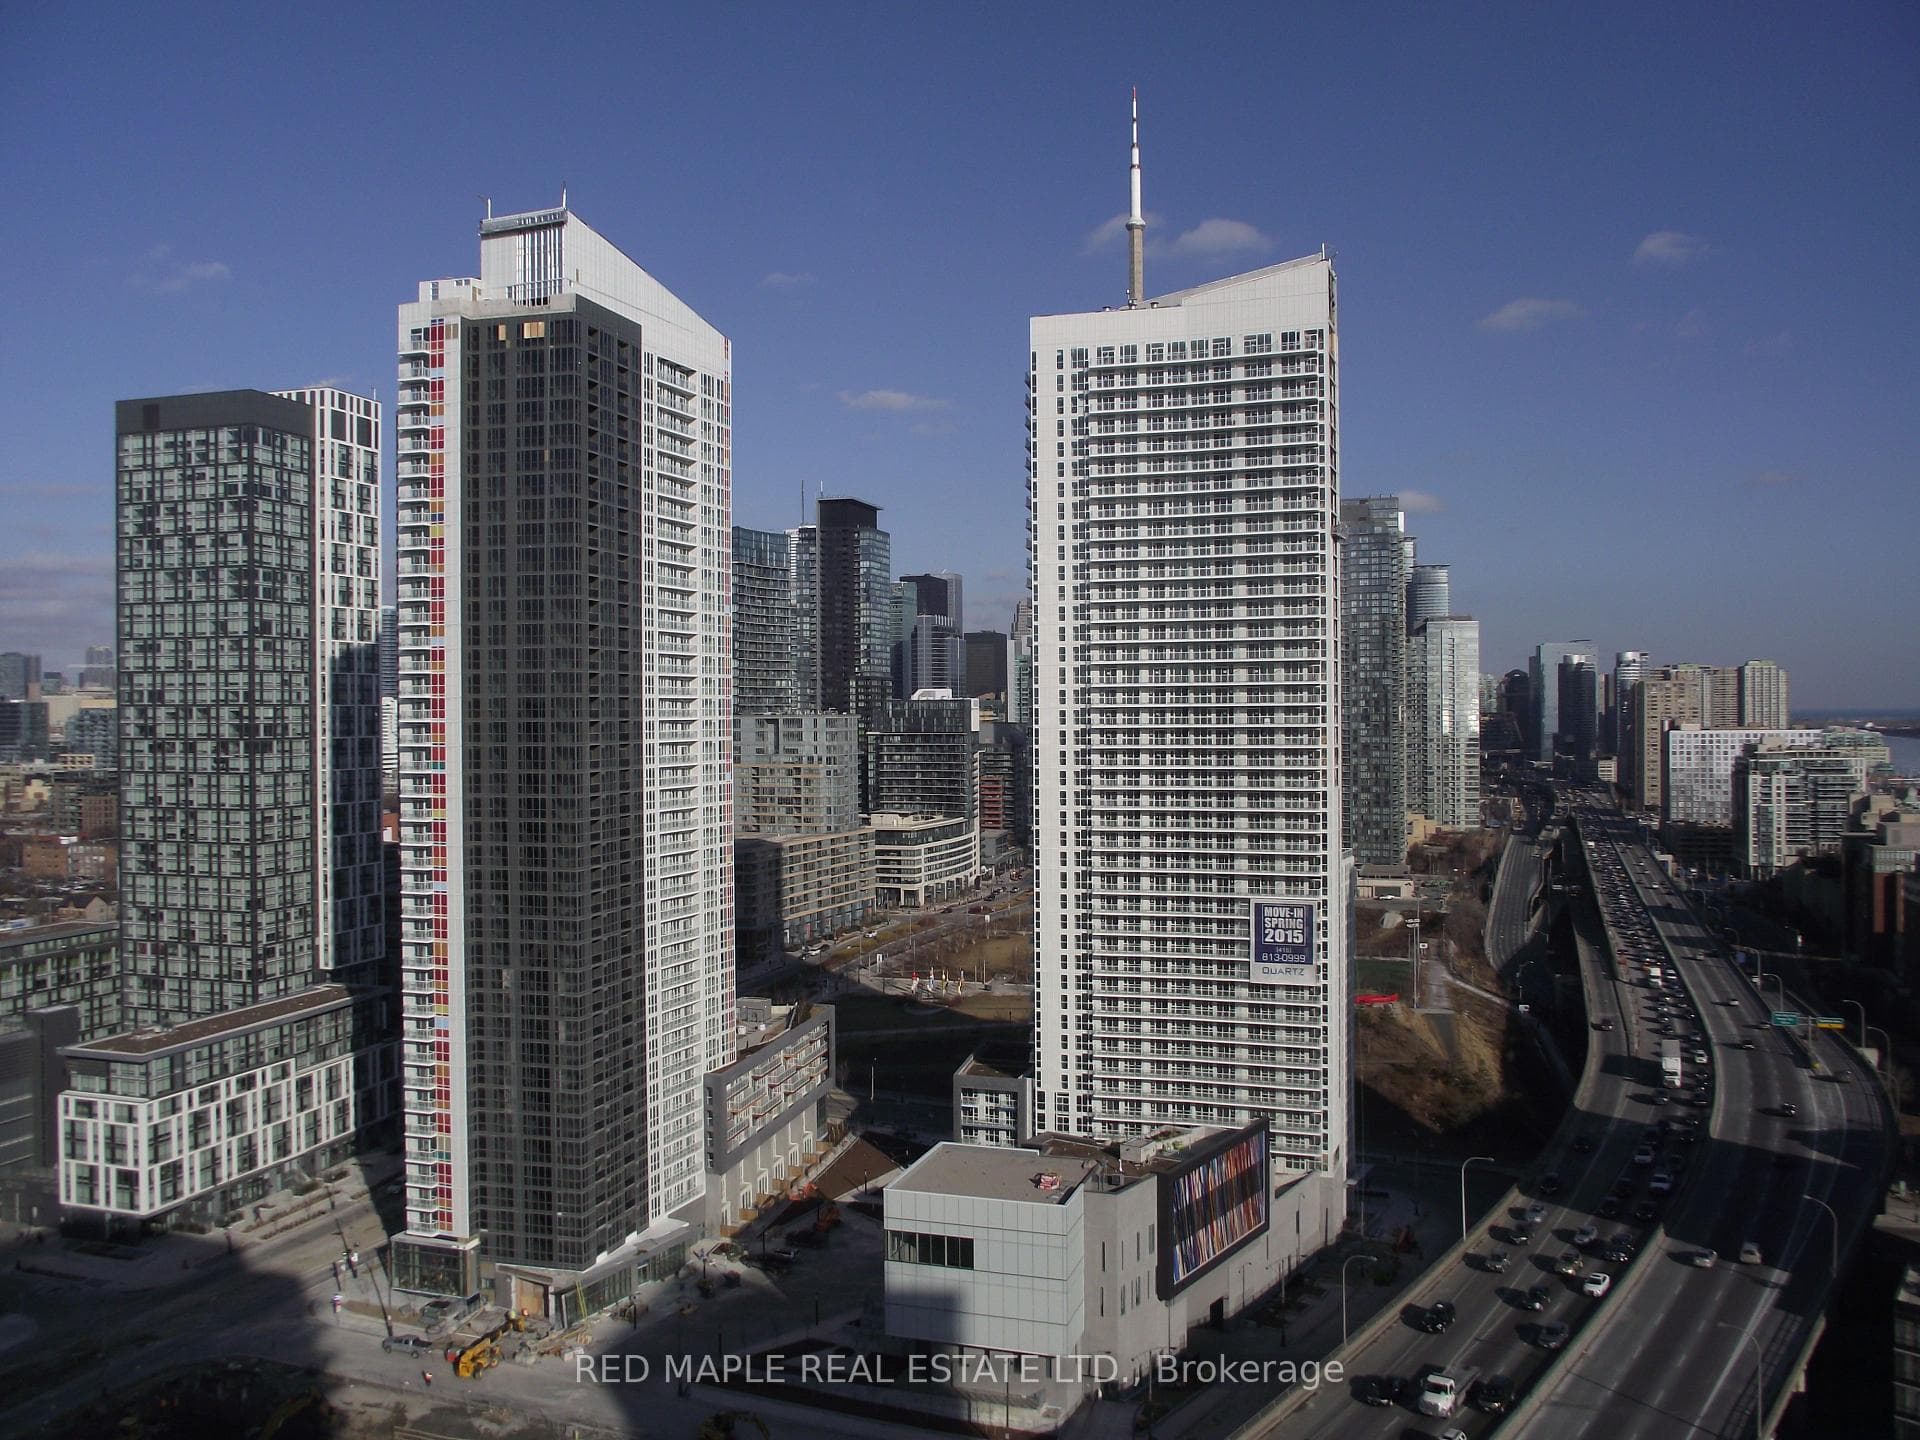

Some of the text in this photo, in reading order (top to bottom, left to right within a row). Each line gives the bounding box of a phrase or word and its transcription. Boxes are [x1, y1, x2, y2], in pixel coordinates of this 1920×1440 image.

[1264, 906, 1304, 918] MOVE-IN
[1264, 917, 1304, 929] SPRING
[1264, 928, 1304, 944] 2015
